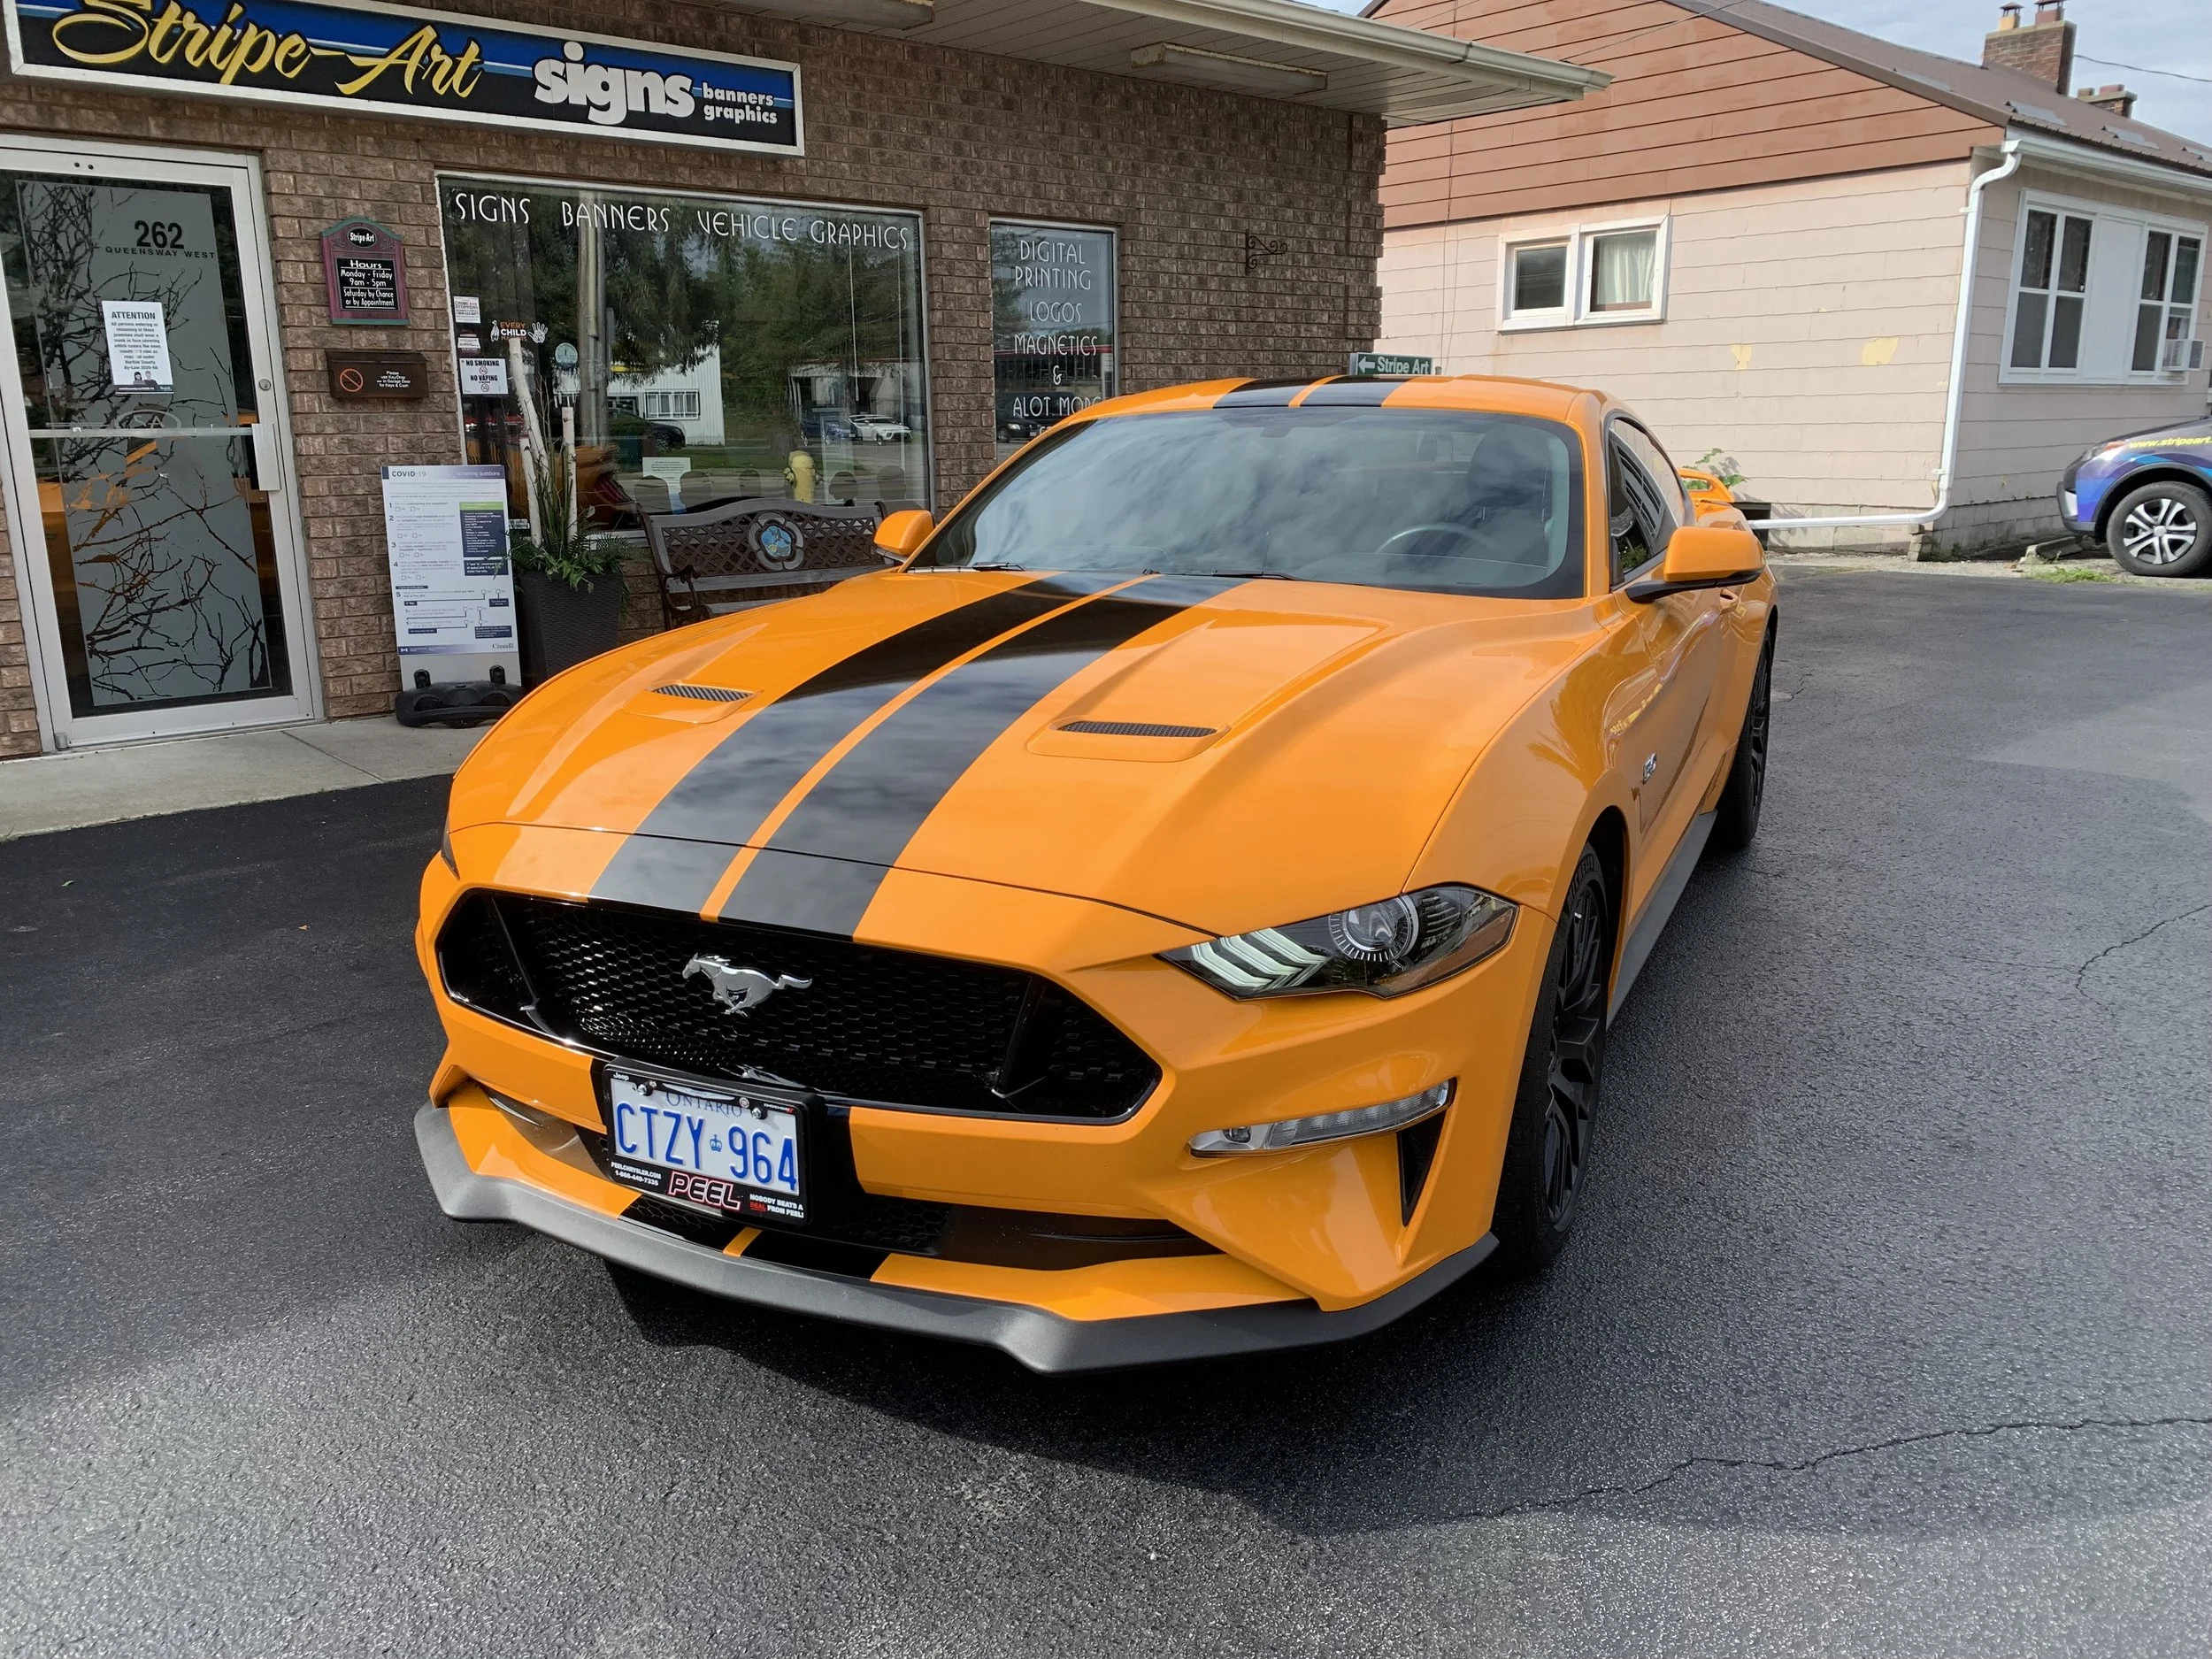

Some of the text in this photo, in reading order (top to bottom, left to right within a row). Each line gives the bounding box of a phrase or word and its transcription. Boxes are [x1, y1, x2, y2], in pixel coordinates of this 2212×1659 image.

[534, 41, 695, 125] signs
[703, 82, 774, 106] banners
[703, 105, 778, 124] graphics
[455, 193, 908, 250] SIGNS BANNERS VEHICLE GRAPHICS
[134, 220, 184, 250] 262
[105, 246, 178, 257] QUEENSWAY
[1019, 240, 1086, 265] DIGITAL
[340, 269, 365, 280] Monday
[373, 270, 392, 280] Friday
[350, 260, 382, 269] Hours
[349, 277, 365, 286] 9am
[372, 279, 386, 288] 5pm
[1015, 265, 1091, 290] PRINTING
[344, 288, 394, 299] Saturday by Chance
[353, 297, 360, 307] by
[361, 298, 394, 307] Appointment
[1029, 301, 1082, 323] LOGOS
[1014, 334, 1098, 357] MAGNETICS
[1052, 365, 1063, 385] &
[1377, 356, 1429, 374] Stripe Art
[1013, 396, 1051, 416] ALOT
[666, 1091, 743, 1118] ONTARIO
[616, 1102, 797, 1191] CTZY 964
[668, 1171, 741, 1211] PEEL
[749, 1193, 776, 1204] NOBODY
[777, 1199, 797, 1209] BEATS
[767, 1205, 785, 1214] FROM
